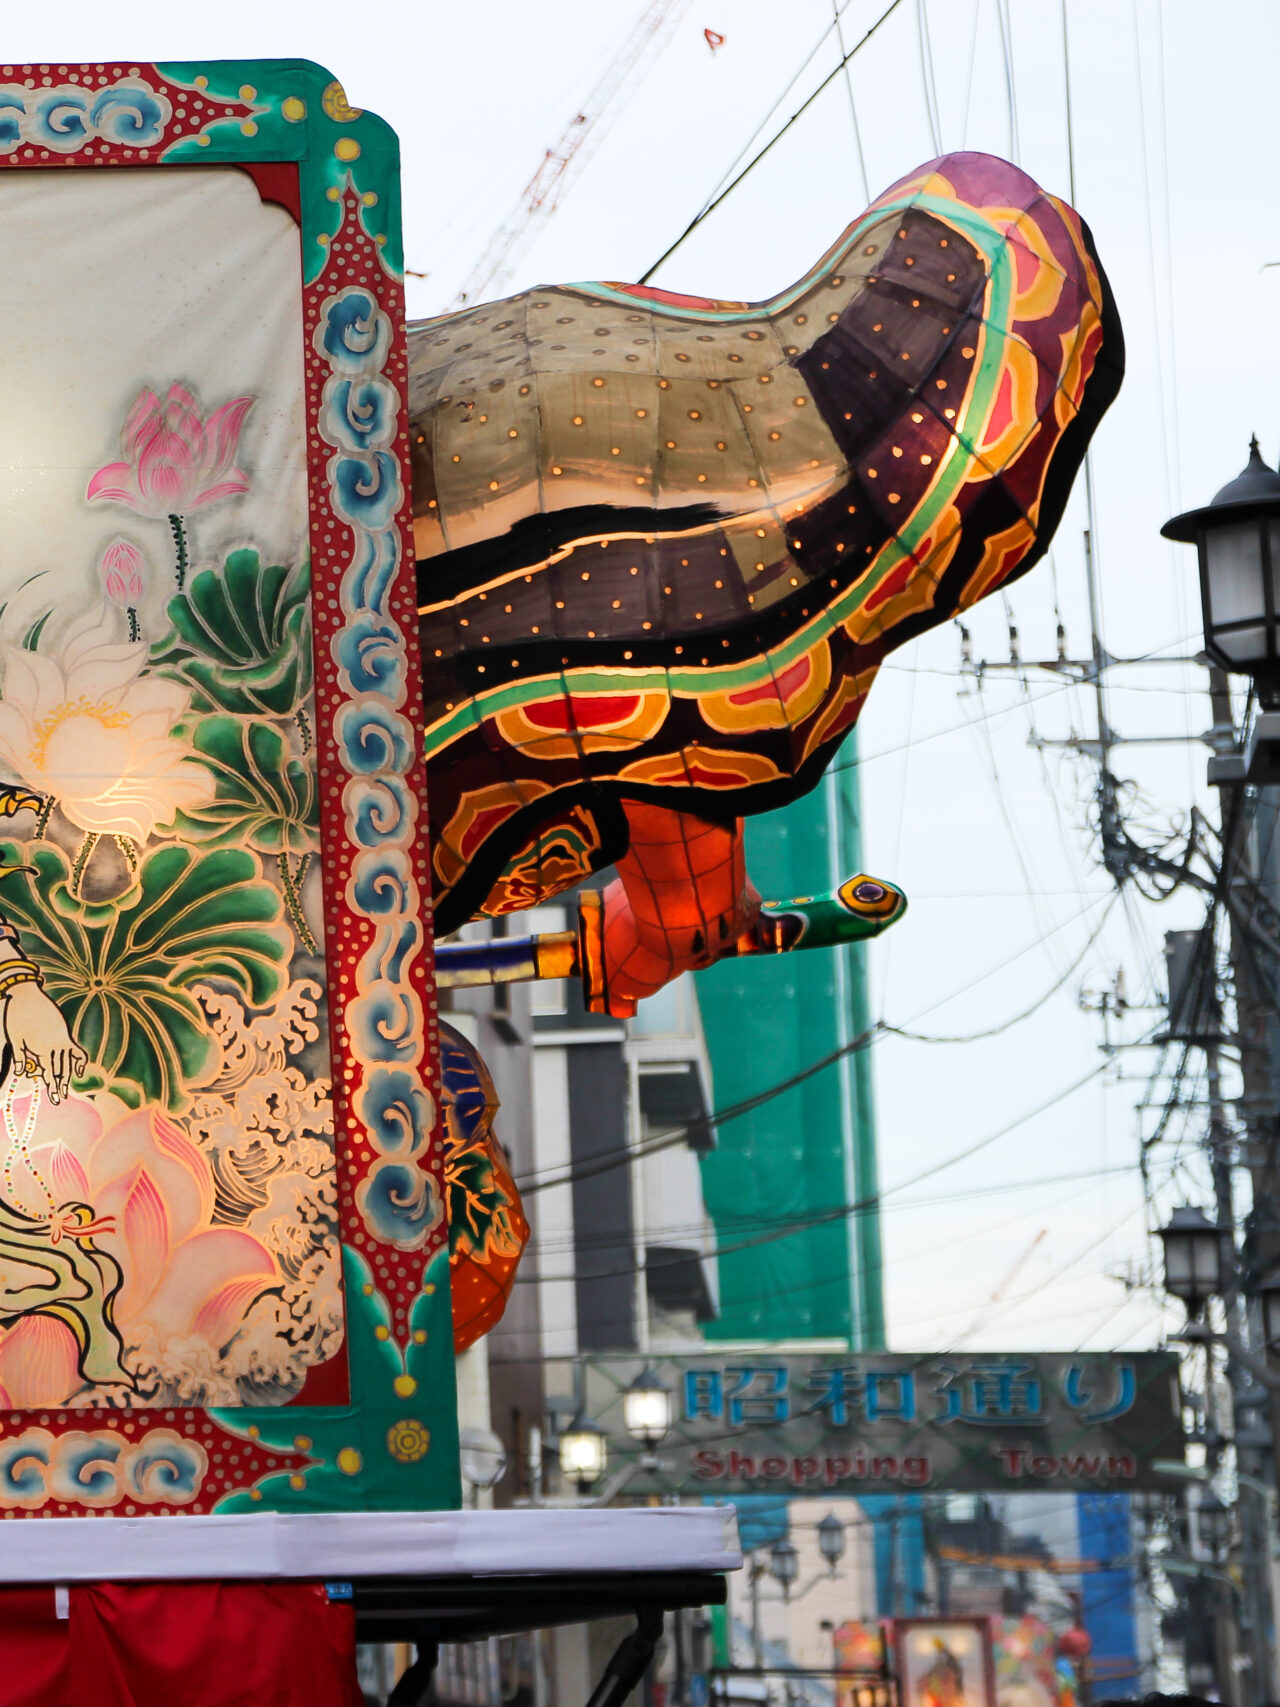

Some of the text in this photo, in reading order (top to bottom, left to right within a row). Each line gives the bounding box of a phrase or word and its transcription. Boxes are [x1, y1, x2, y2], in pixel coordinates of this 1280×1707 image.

[683, 1363, 1136, 1427] 昭和通り
[694, 1449, 1135, 1486] Shopping Town
